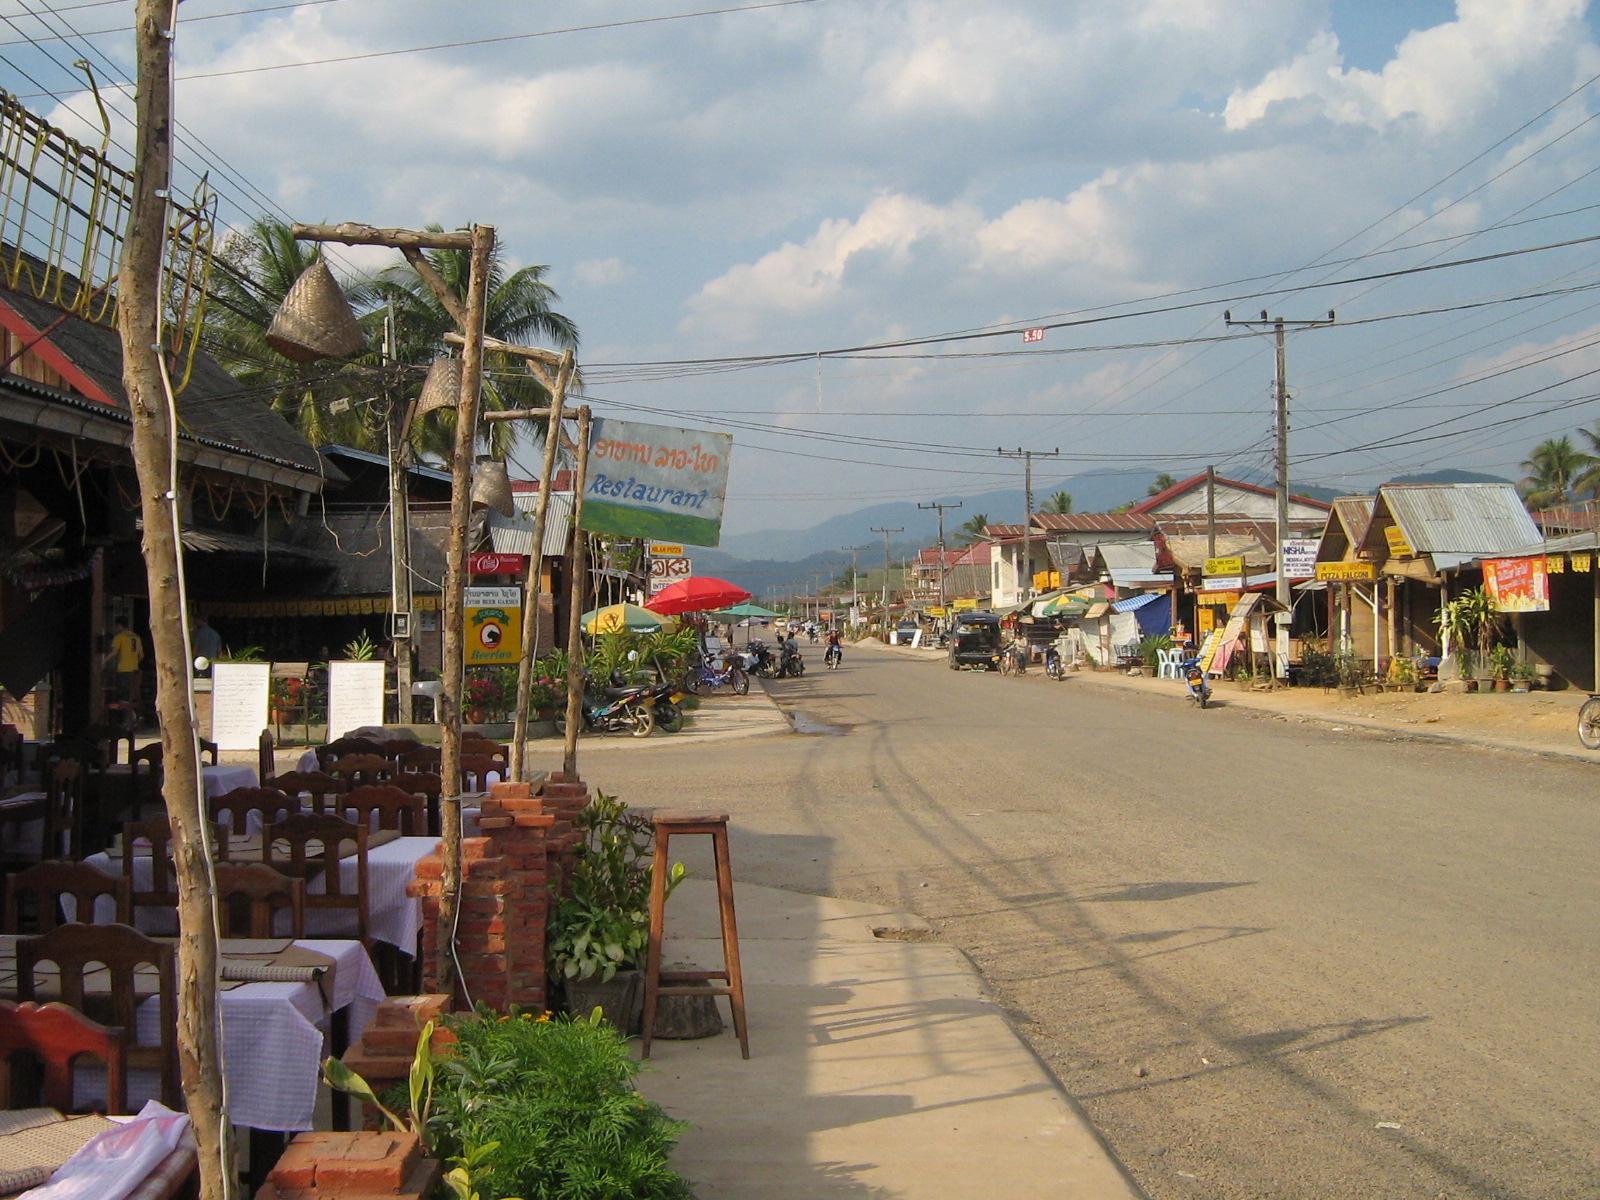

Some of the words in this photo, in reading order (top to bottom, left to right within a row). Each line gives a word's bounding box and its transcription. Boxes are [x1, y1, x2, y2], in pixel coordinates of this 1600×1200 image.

[1024, 329, 1043, 342] 5.50
[587, 473, 709, 509] Restaurant
[1283, 546, 1305, 555] NISHA
[1320, 572, 1339, 580] PIZZA
[471, 650, 512, 661] Beerlao
